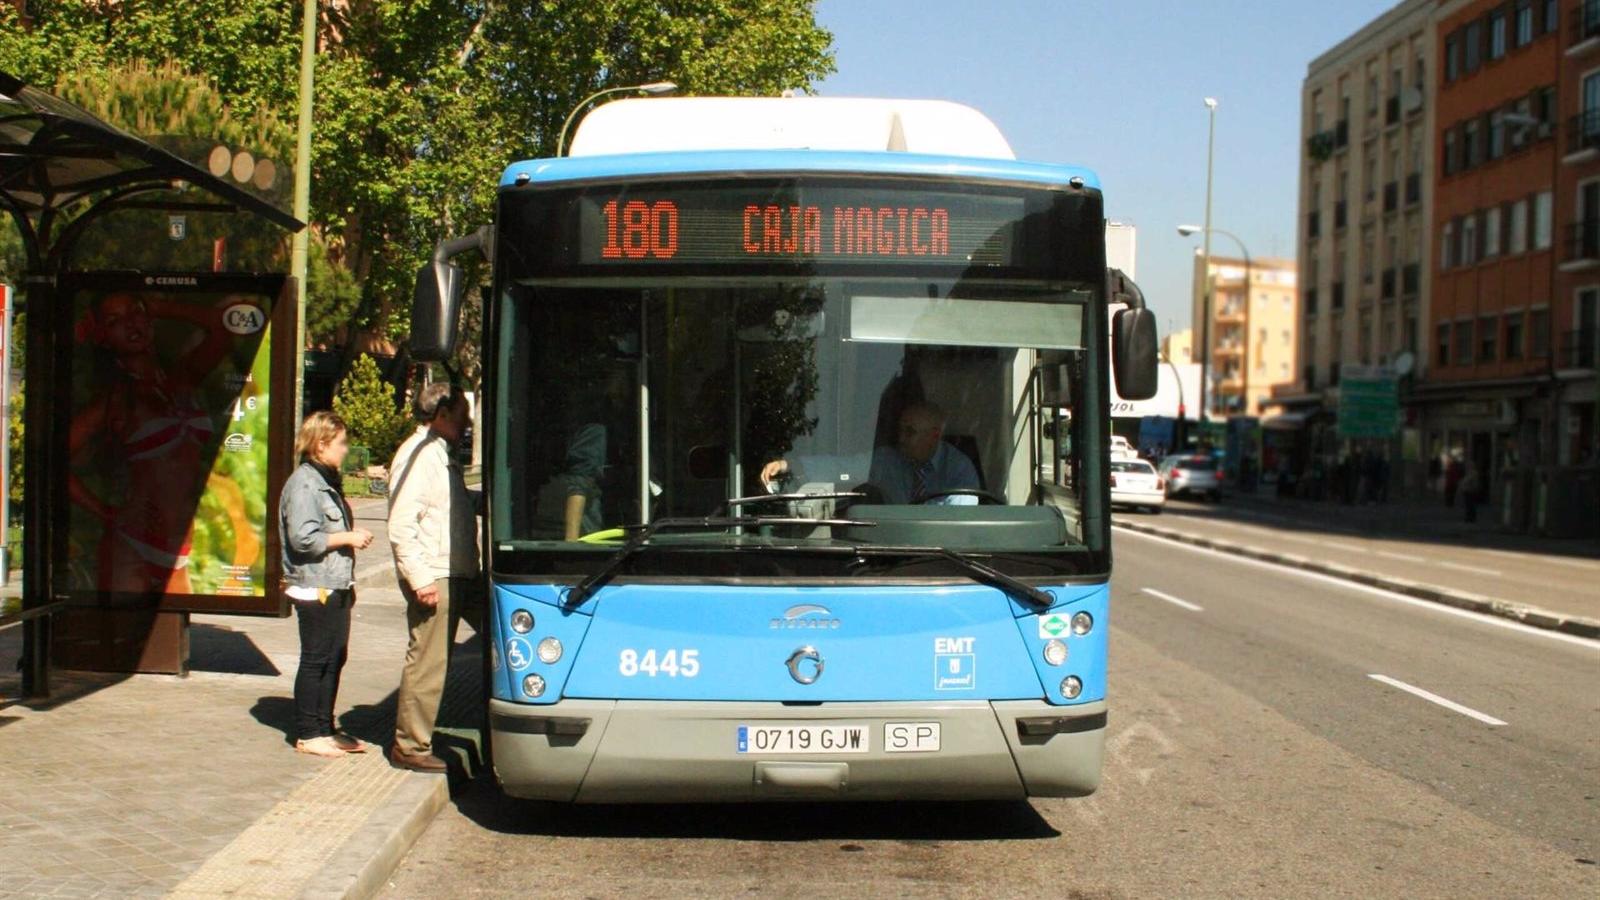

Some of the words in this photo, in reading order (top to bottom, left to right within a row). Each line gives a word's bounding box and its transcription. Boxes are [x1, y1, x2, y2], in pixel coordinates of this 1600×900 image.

[602, 200, 678, 258] 180
[744, 206, 821, 253] CAJA
[834, 207, 949, 255] MAGICA
[155, 276, 198, 285] CEMUSA
[227, 310, 259, 328] C&A
[935, 637, 976, 653] EMT
[619, 648, 700, 677] 8445
[755, 729, 811, 750] 0719
[820, 729, 861, 749] GJW
